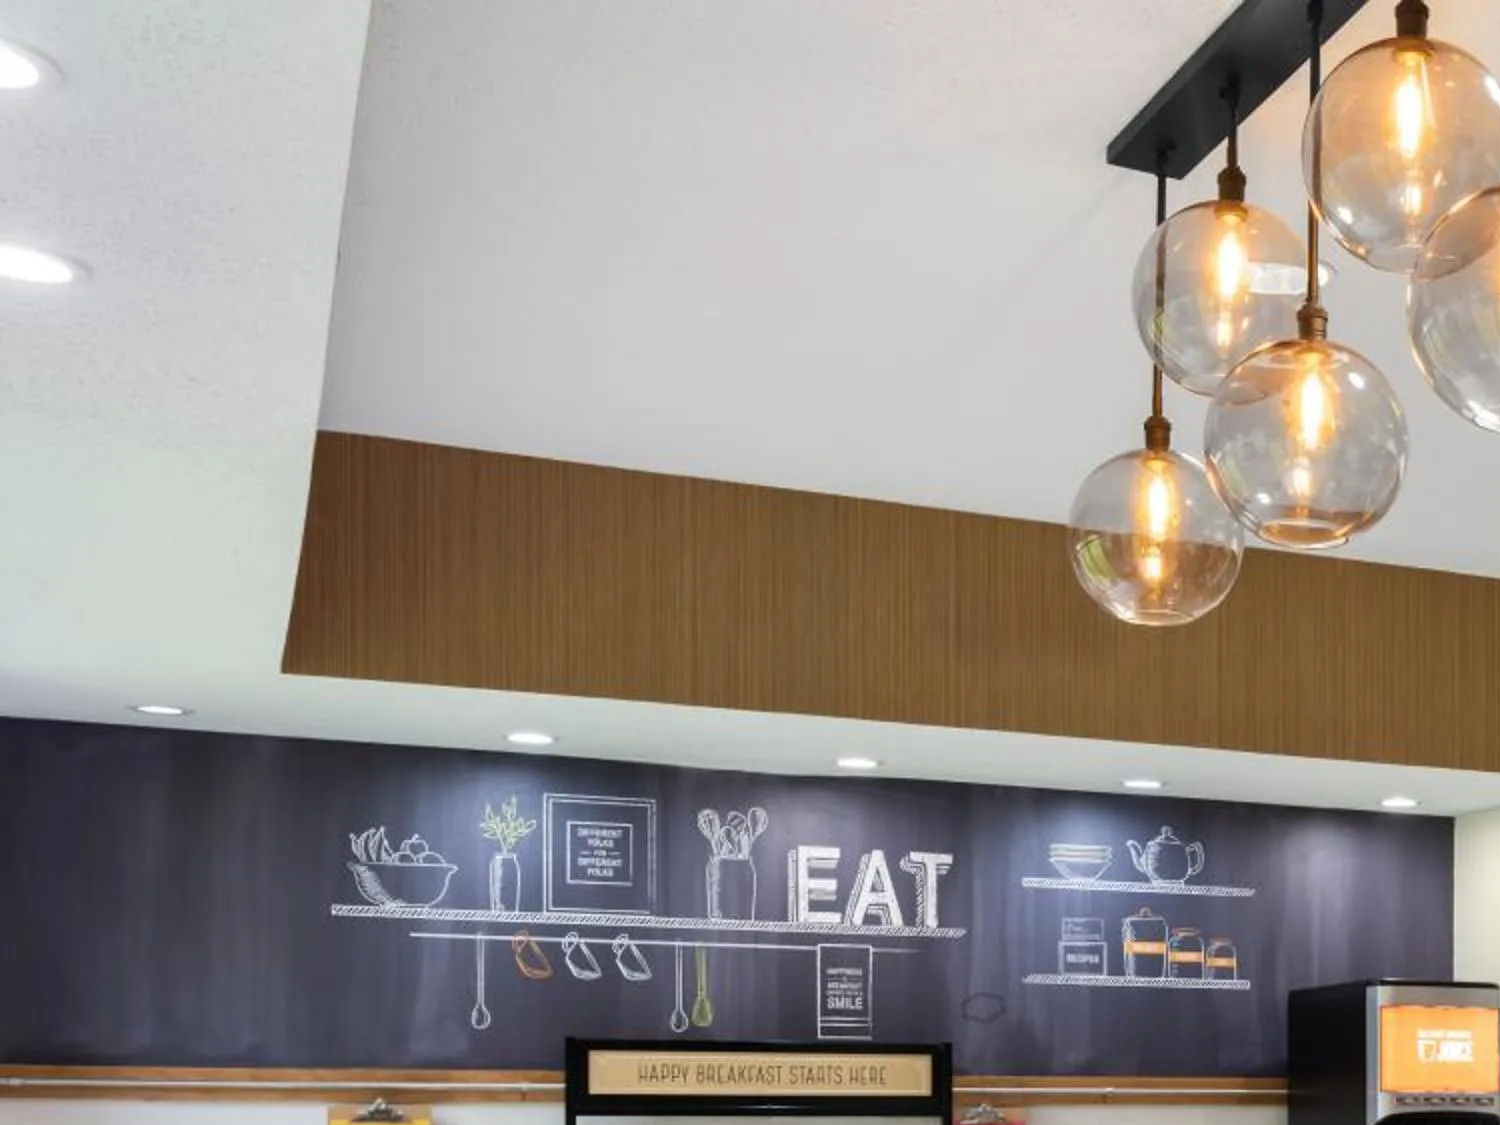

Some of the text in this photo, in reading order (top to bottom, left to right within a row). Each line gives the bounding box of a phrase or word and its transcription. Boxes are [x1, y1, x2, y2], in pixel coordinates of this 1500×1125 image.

[788, 845, 953, 929] EAT
[827, 996, 863, 1010] SMILE
[638, 1063, 887, 1086] HAPPY BREAKFAST STARTS HERE
